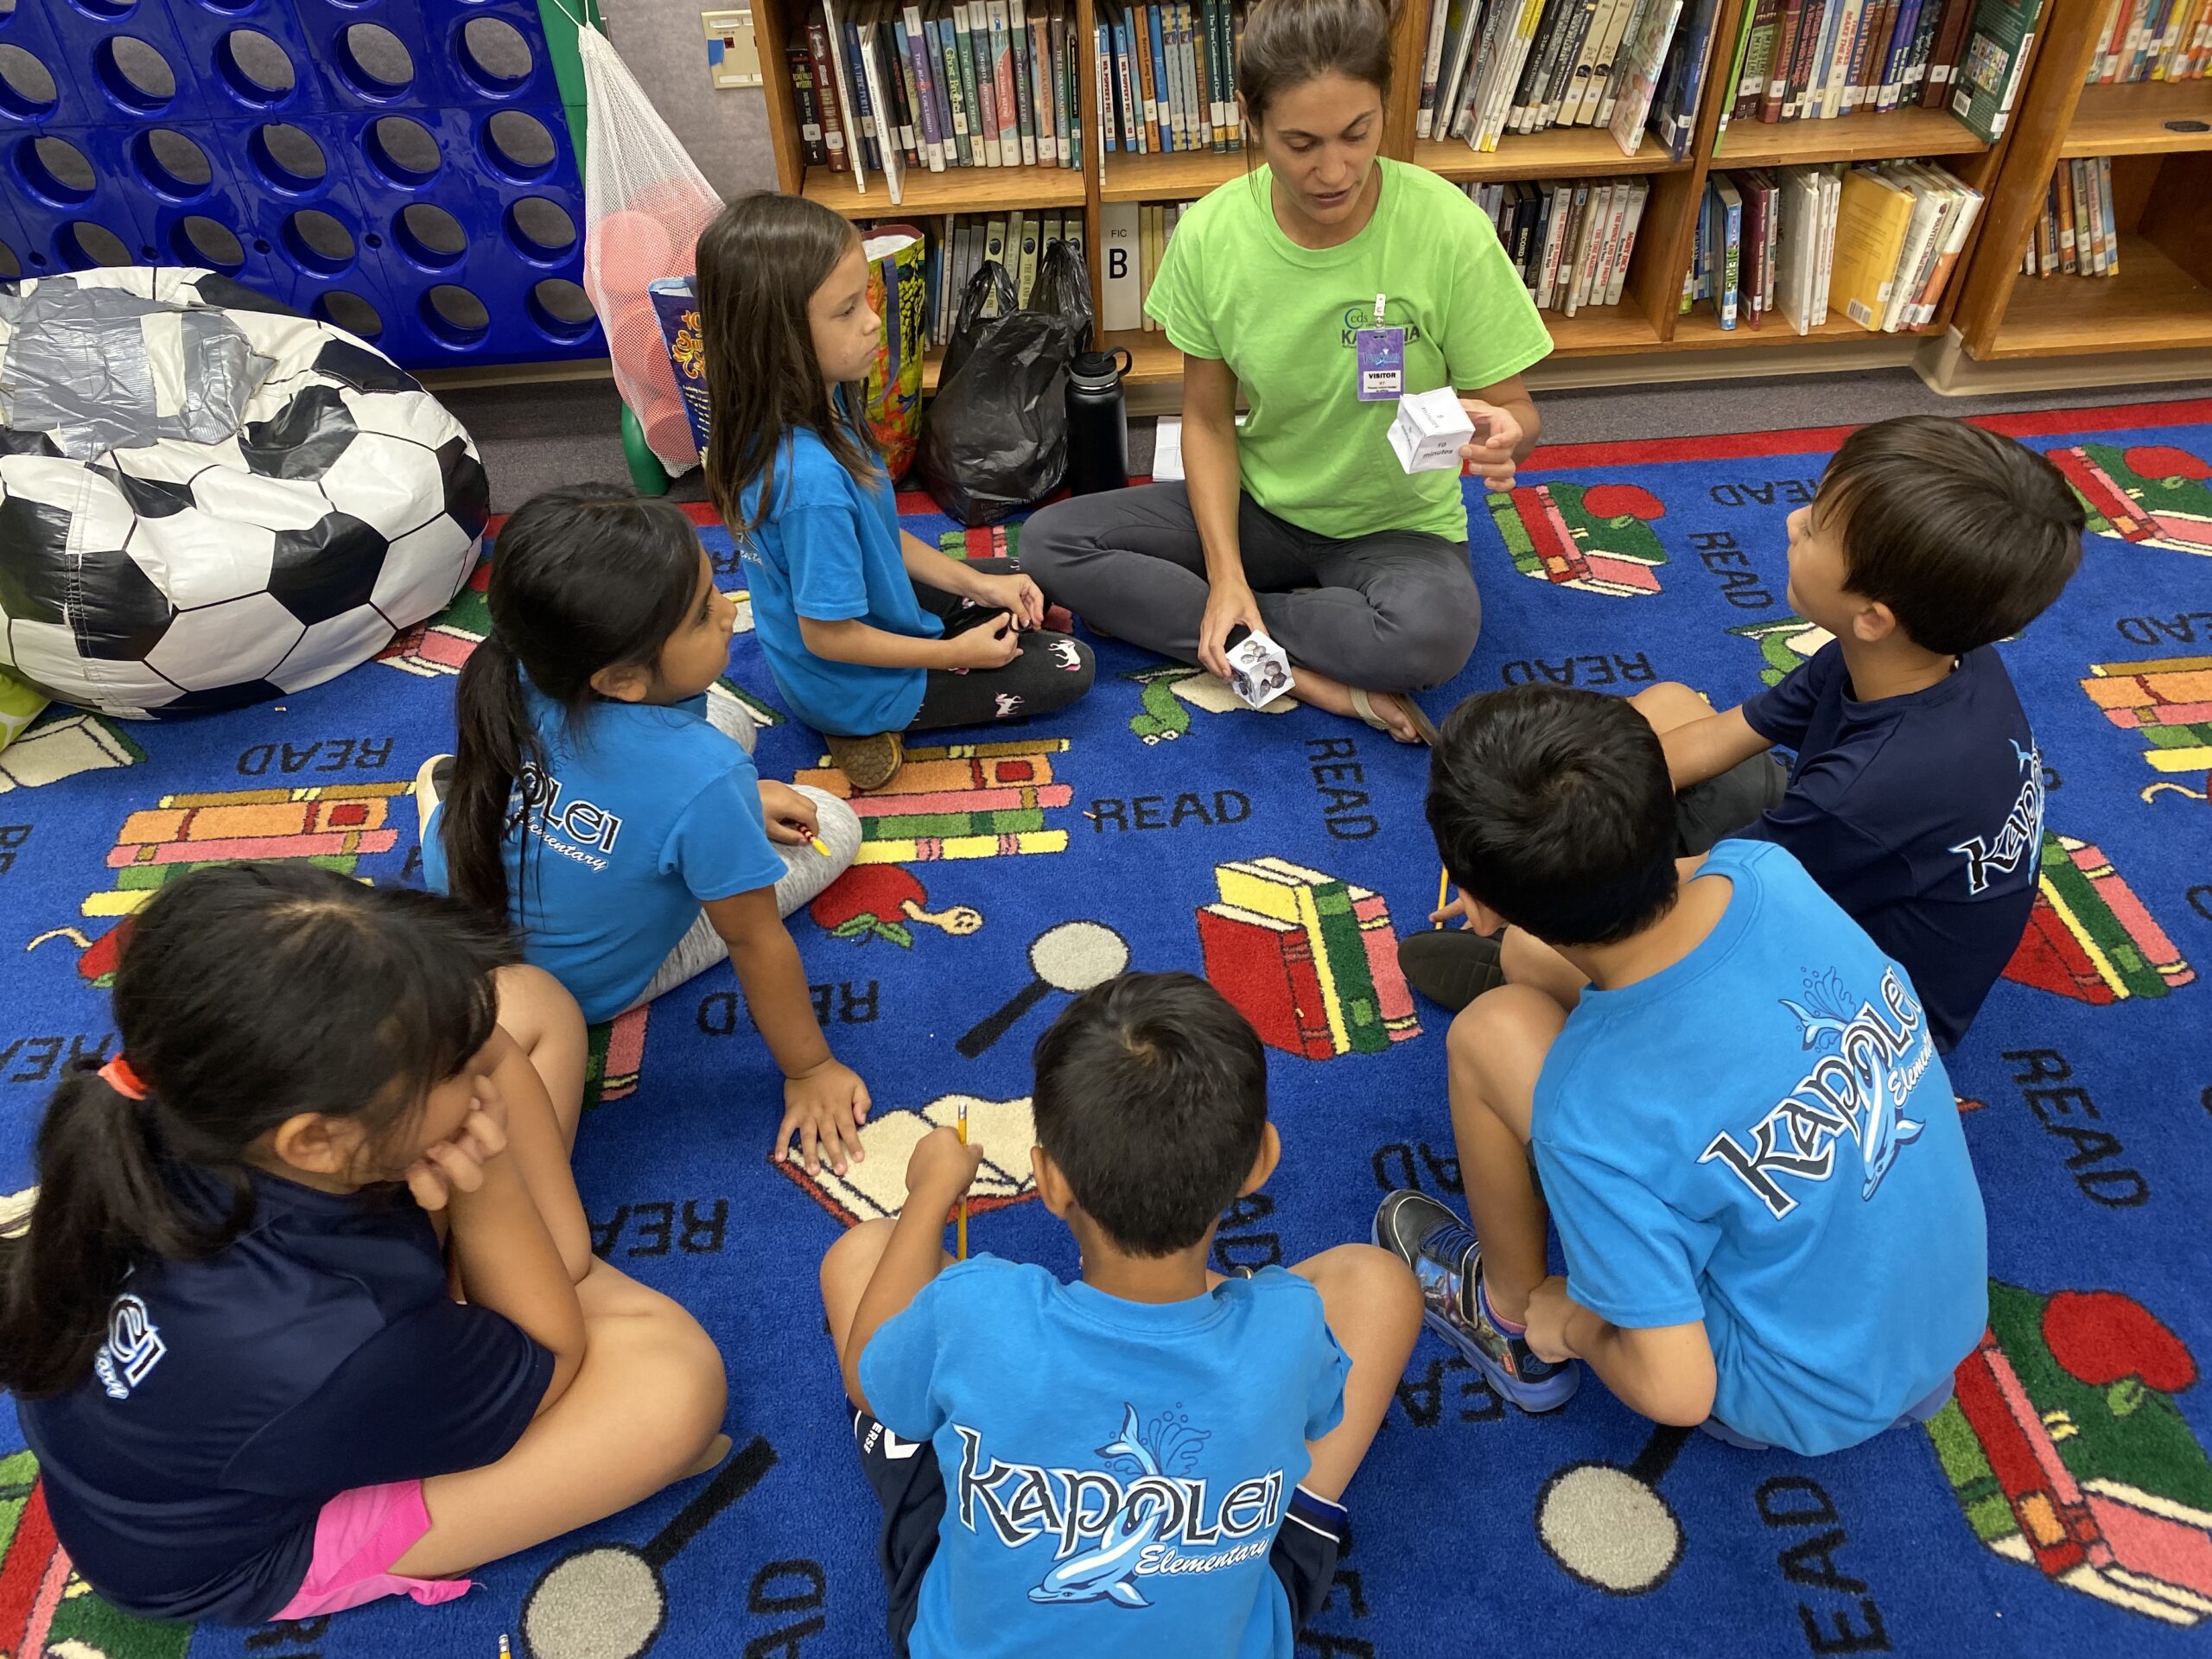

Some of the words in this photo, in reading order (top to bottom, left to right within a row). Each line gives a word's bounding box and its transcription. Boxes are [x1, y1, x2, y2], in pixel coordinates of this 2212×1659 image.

[1802, 13, 1813, 39] Brush
[1811, 10, 1823, 36] Brush
[1841, 10, 1853, 36] MAKE
[1538, 34, 1549, 52] Star
[1797, 41, 1808, 60] with
[1808, 39, 1817, 57] with
[1839, 39, 1847, 54] THE
[1844, 37, 1855, 65] MOVES
[1225, 41, 1234, 75] Confessions
[944, 48, 956, 77] Ghost
[950, 79, 963, 114] Brother
[1524, 54, 1543, 92] Hatchling
[1111, 229, 1128, 238] FIC
[1518, 227, 1529, 257] SECOND
[1611, 224, 1620, 243] PRINCE
[1623, 232, 1635, 254] MOBY
[1109, 248, 1128, 279] B
[1586, 255, 1597, 279] MACHINE
[1600, 267, 1611, 287] PAUPER
[1619, 256, 1629, 273] DICK
[1726, 249, 1738, 292] NERDS
[1422, 448, 1454, 459] minutes
[1709, 480, 1817, 507] EAD
[1688, 531, 1775, 610] READ
[1500, 652, 1657, 688] READ
[237, 738, 394, 775] READ
[1305, 737, 1381, 841] READ
[1090, 789, 1252, 834] READ
[696, 979, 880, 1036] RED
[2000, 1048, 2150, 1208] READ
[590, 1198, 729, 1258] REA
[1133, 1534, 1270, 1577] Elementary
[1754, 1476, 1896, 1655] EAD
